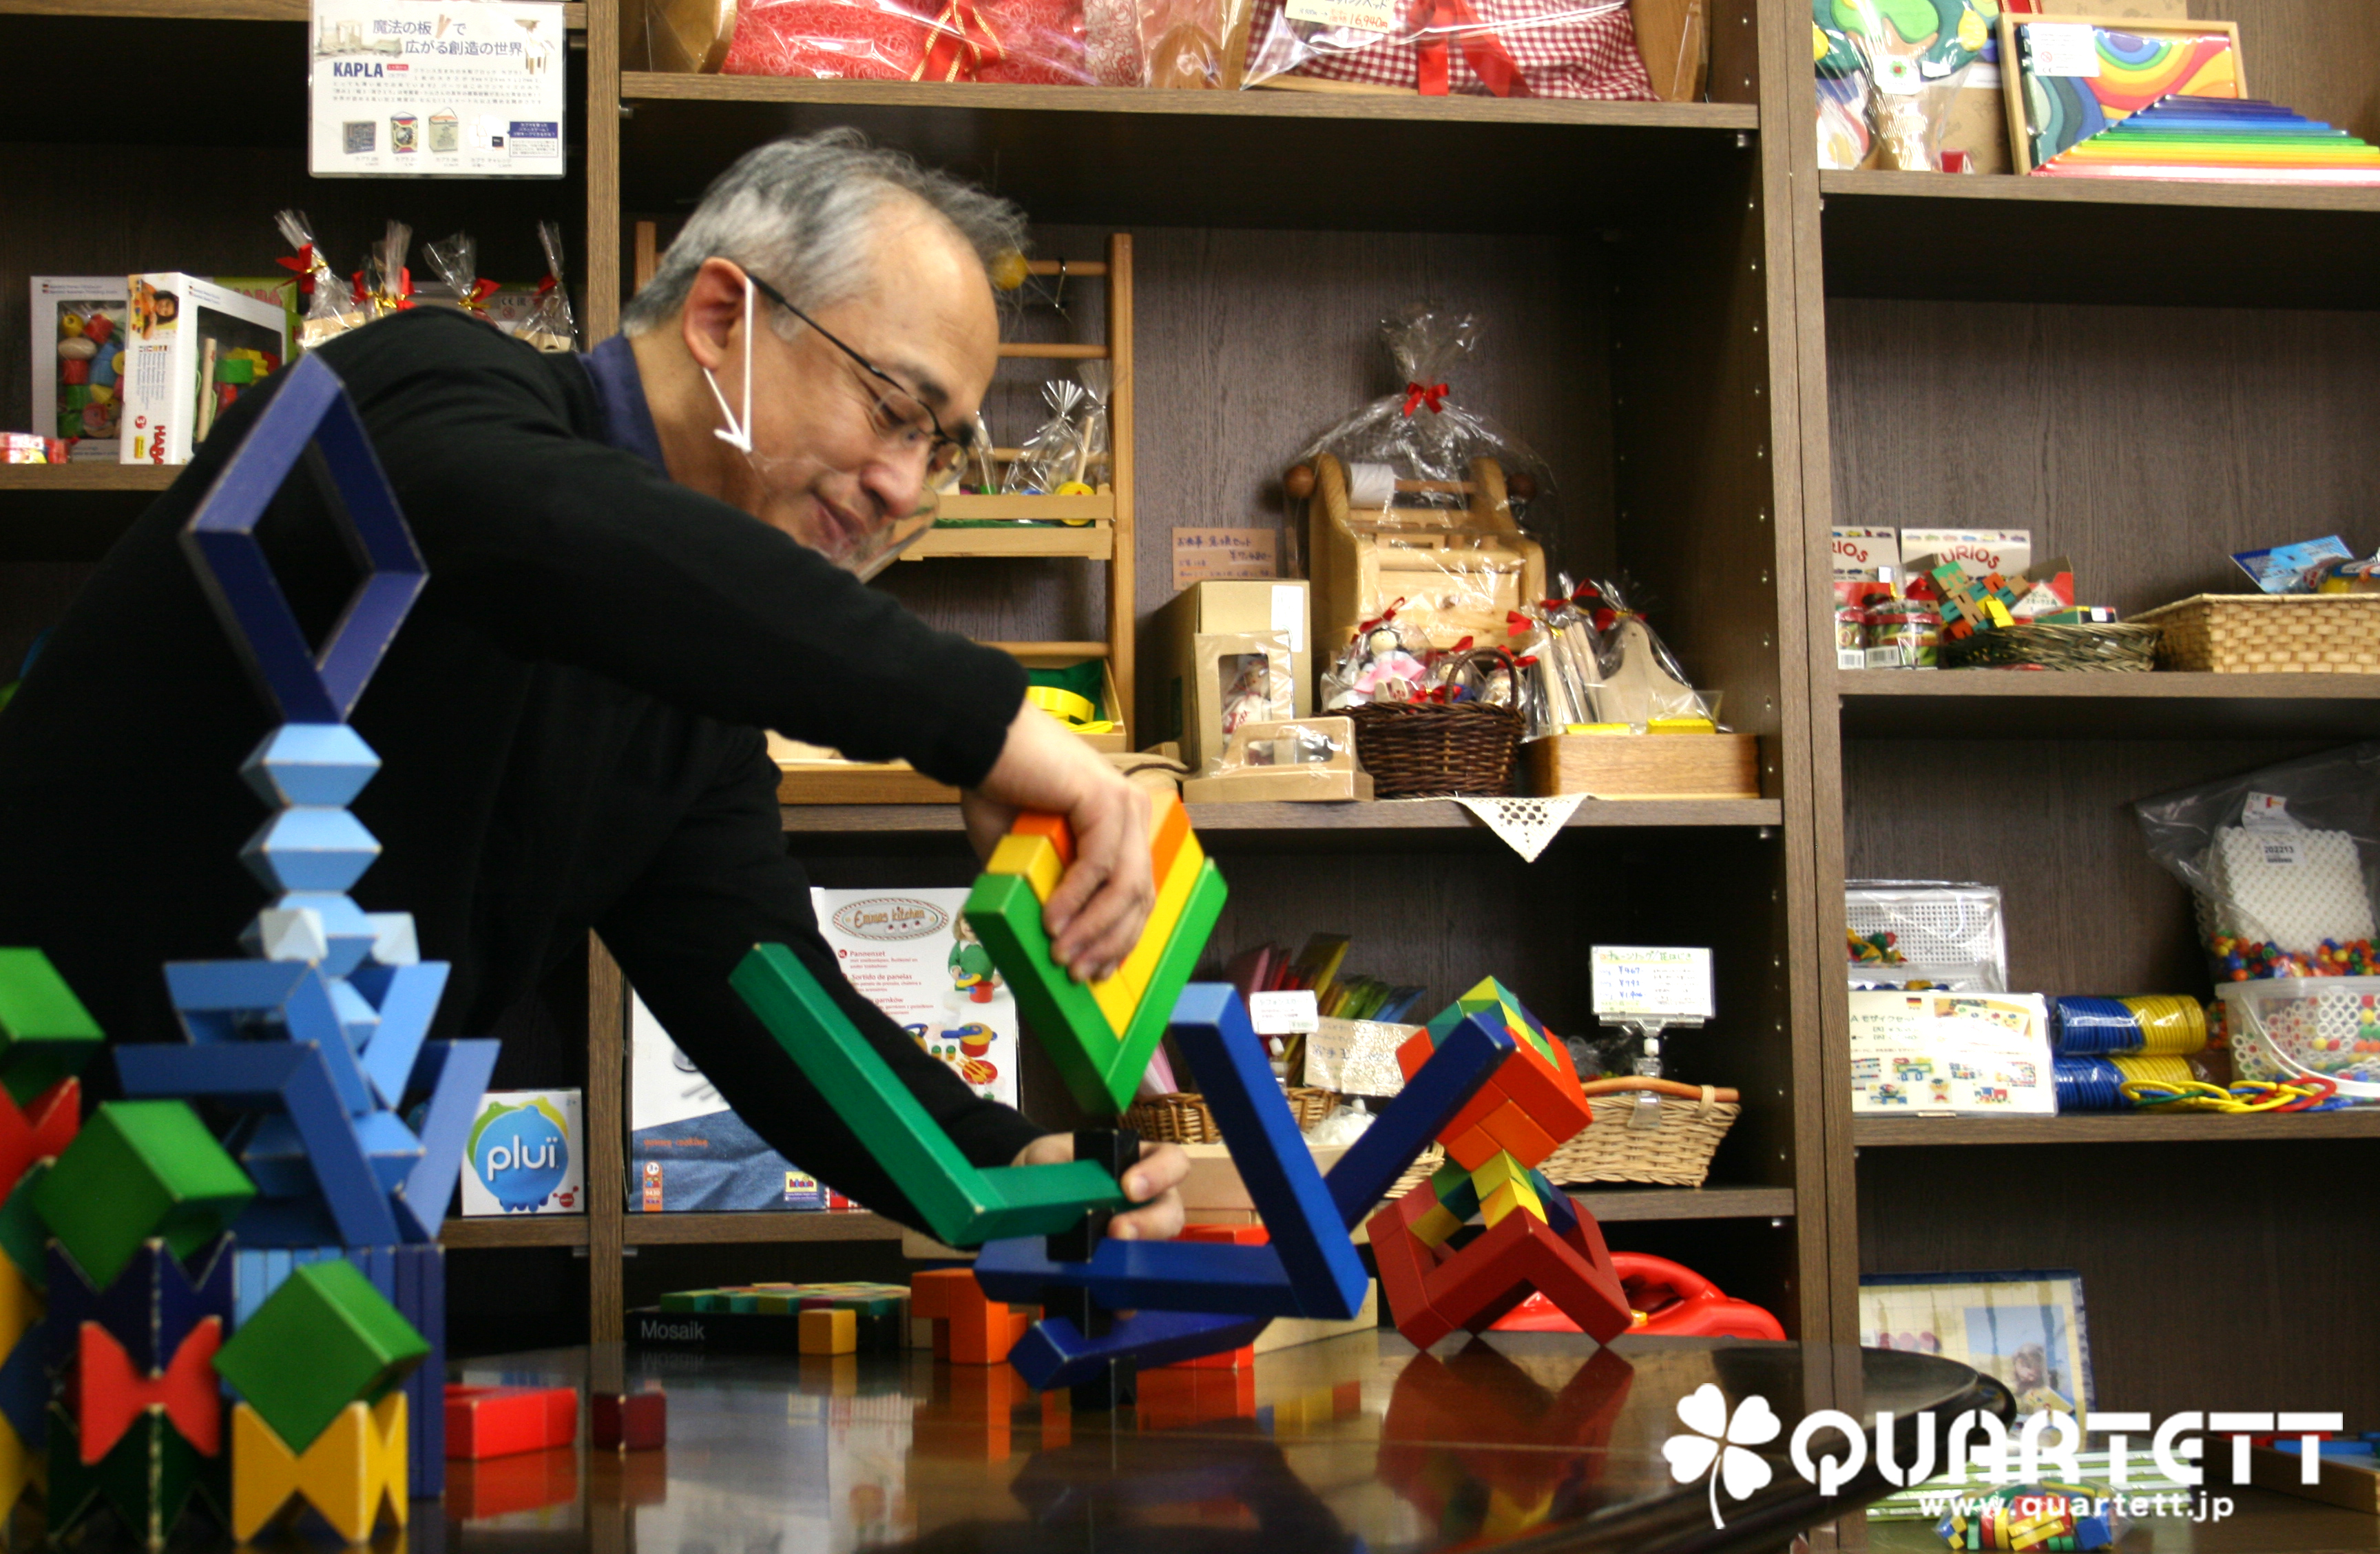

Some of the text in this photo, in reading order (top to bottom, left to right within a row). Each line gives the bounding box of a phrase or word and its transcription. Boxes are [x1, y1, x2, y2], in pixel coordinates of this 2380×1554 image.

[373, 19, 467, 36] 魔法の板 で
[405, 40, 523, 56] 広がる創造の世界
[333, 62, 384, 78] KAPLA
[149, 425, 167, 465] HABA
[1941, 544, 2000, 569] URIOS
[854, 906, 926, 929] Emmas kitchen
[887, 973, 913, 982] panelas
[487, 1134, 559, 1182] pluï
[641, 1319, 705, 1340] Mosaik
